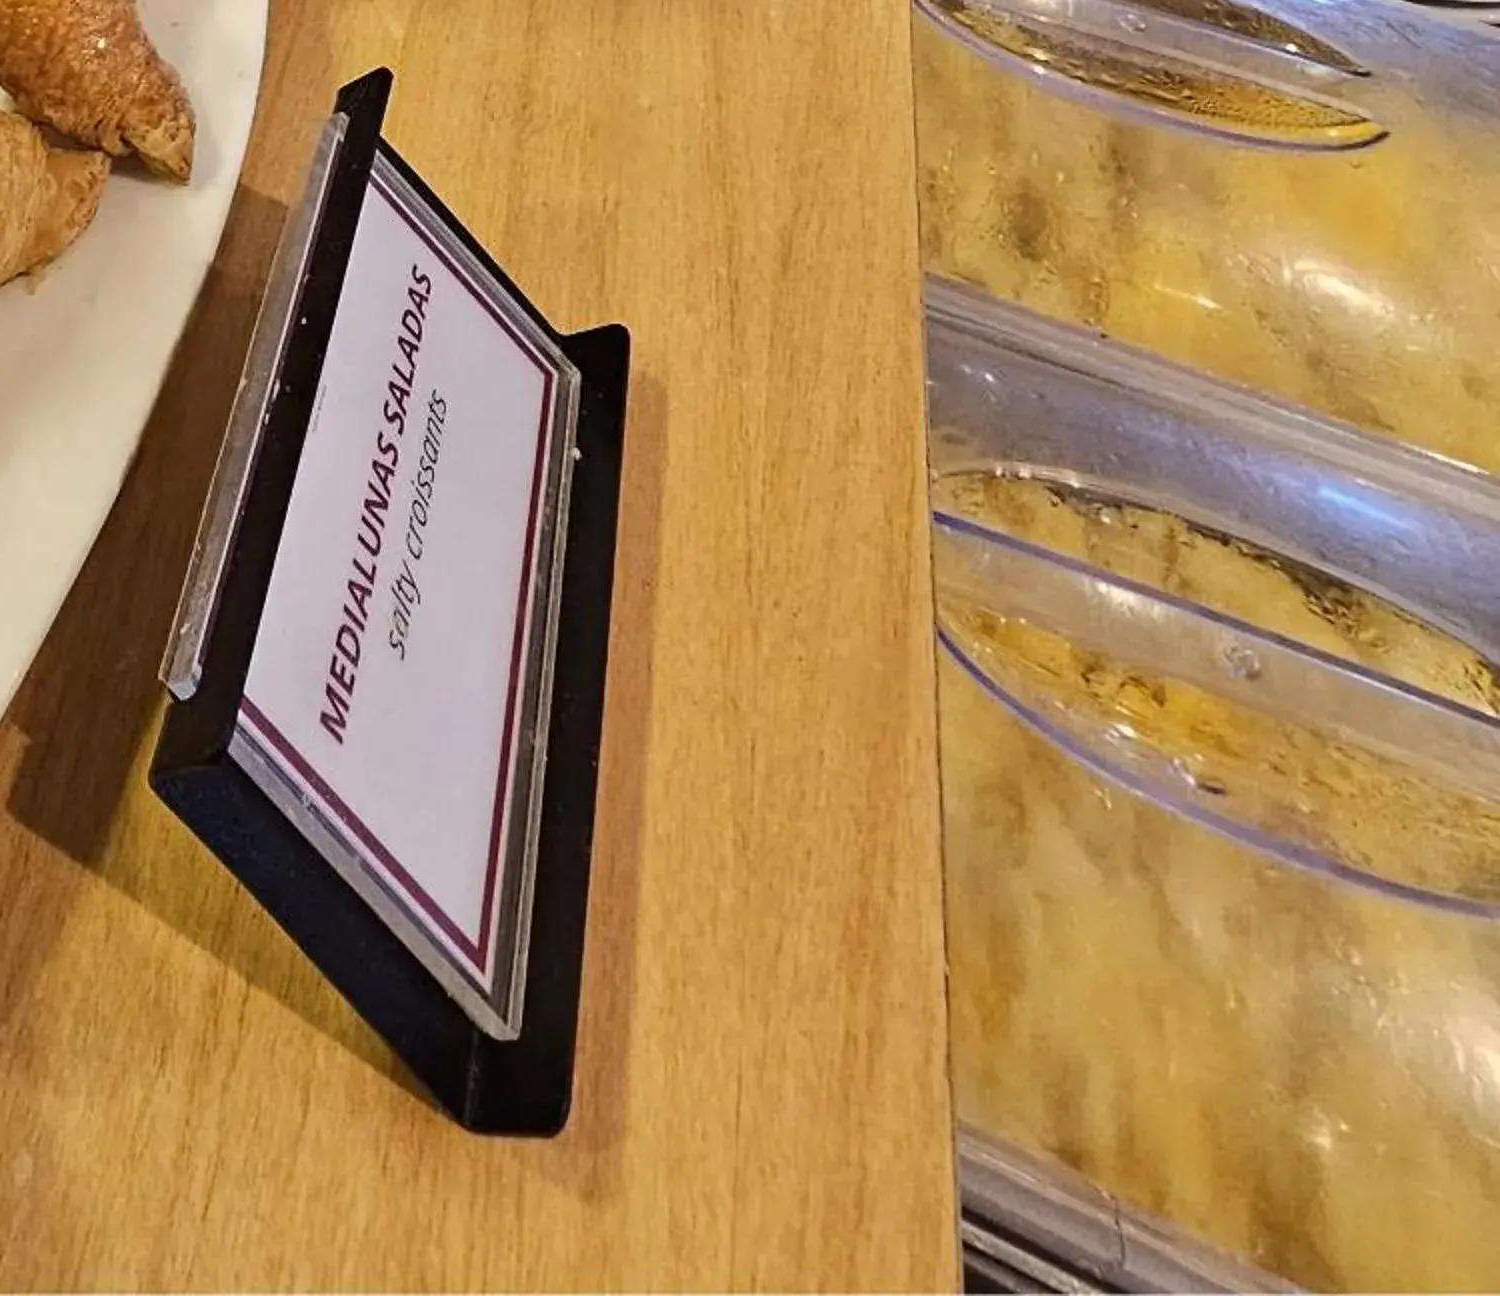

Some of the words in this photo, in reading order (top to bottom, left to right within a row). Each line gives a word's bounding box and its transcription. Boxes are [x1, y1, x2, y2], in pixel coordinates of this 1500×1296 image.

[319, 431, 400, 746] MEDIALUNAS
[382, 263, 432, 436] SALADAS
[389, 559, 421, 661] salty
[405, 388, 448, 561] croissants
